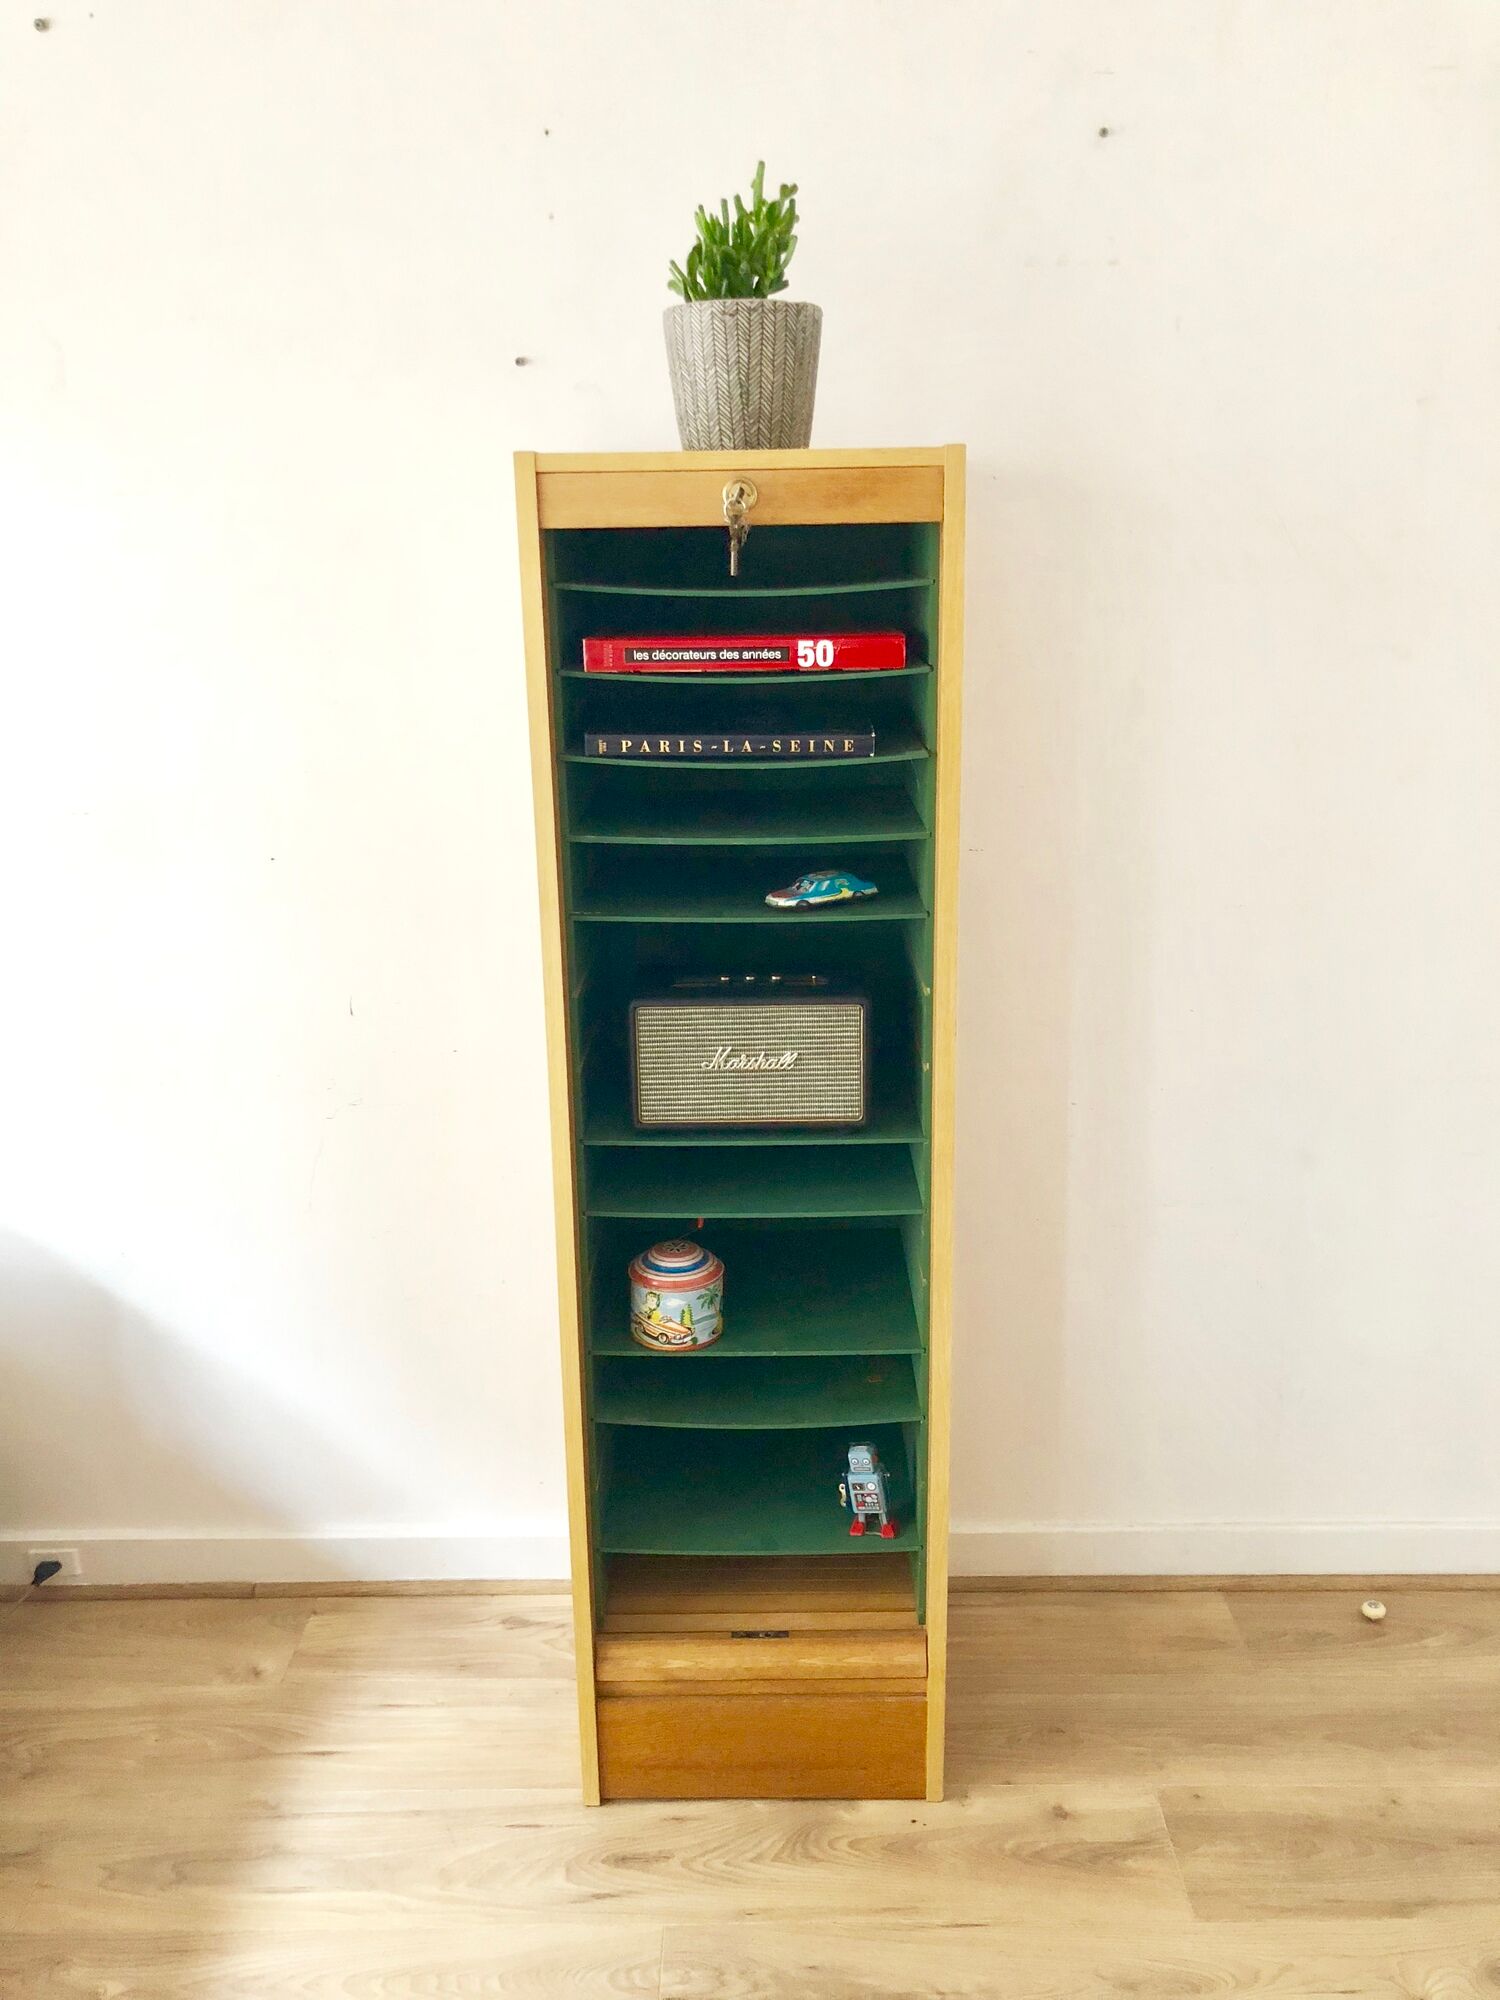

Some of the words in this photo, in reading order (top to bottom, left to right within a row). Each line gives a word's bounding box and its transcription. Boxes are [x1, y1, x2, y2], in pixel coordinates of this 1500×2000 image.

[633, 649, 649, 661] les
[651, 648, 716, 661] décorateurs
[719, 648, 739, 660] des
[742, 648, 782, 660] années
[797, 640, 834, 667] 50
[701, 1046, 798, 1070] Marshall
